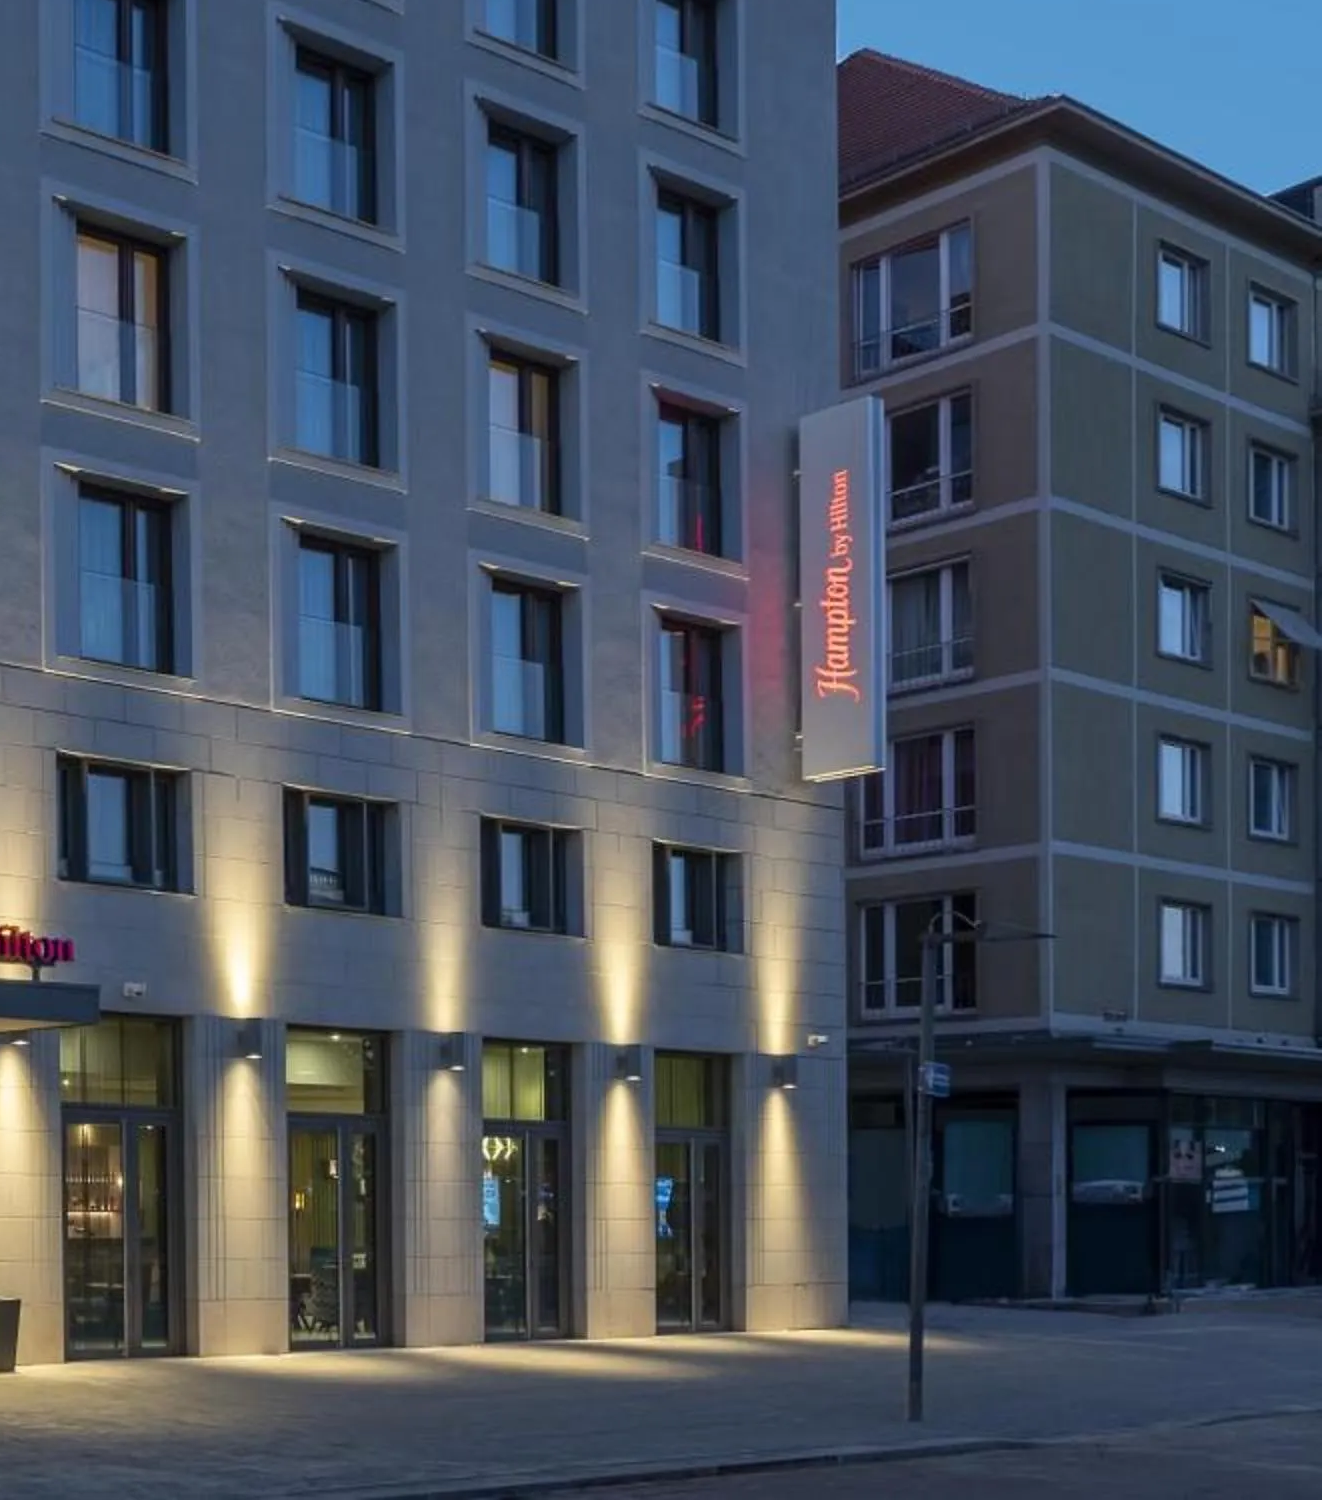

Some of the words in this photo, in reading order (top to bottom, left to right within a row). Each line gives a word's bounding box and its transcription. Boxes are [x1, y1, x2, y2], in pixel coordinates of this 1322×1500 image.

[829, 468, 849, 531] Hilton
[830, 533, 853, 558] by
[815, 558, 860, 703] Hampton
